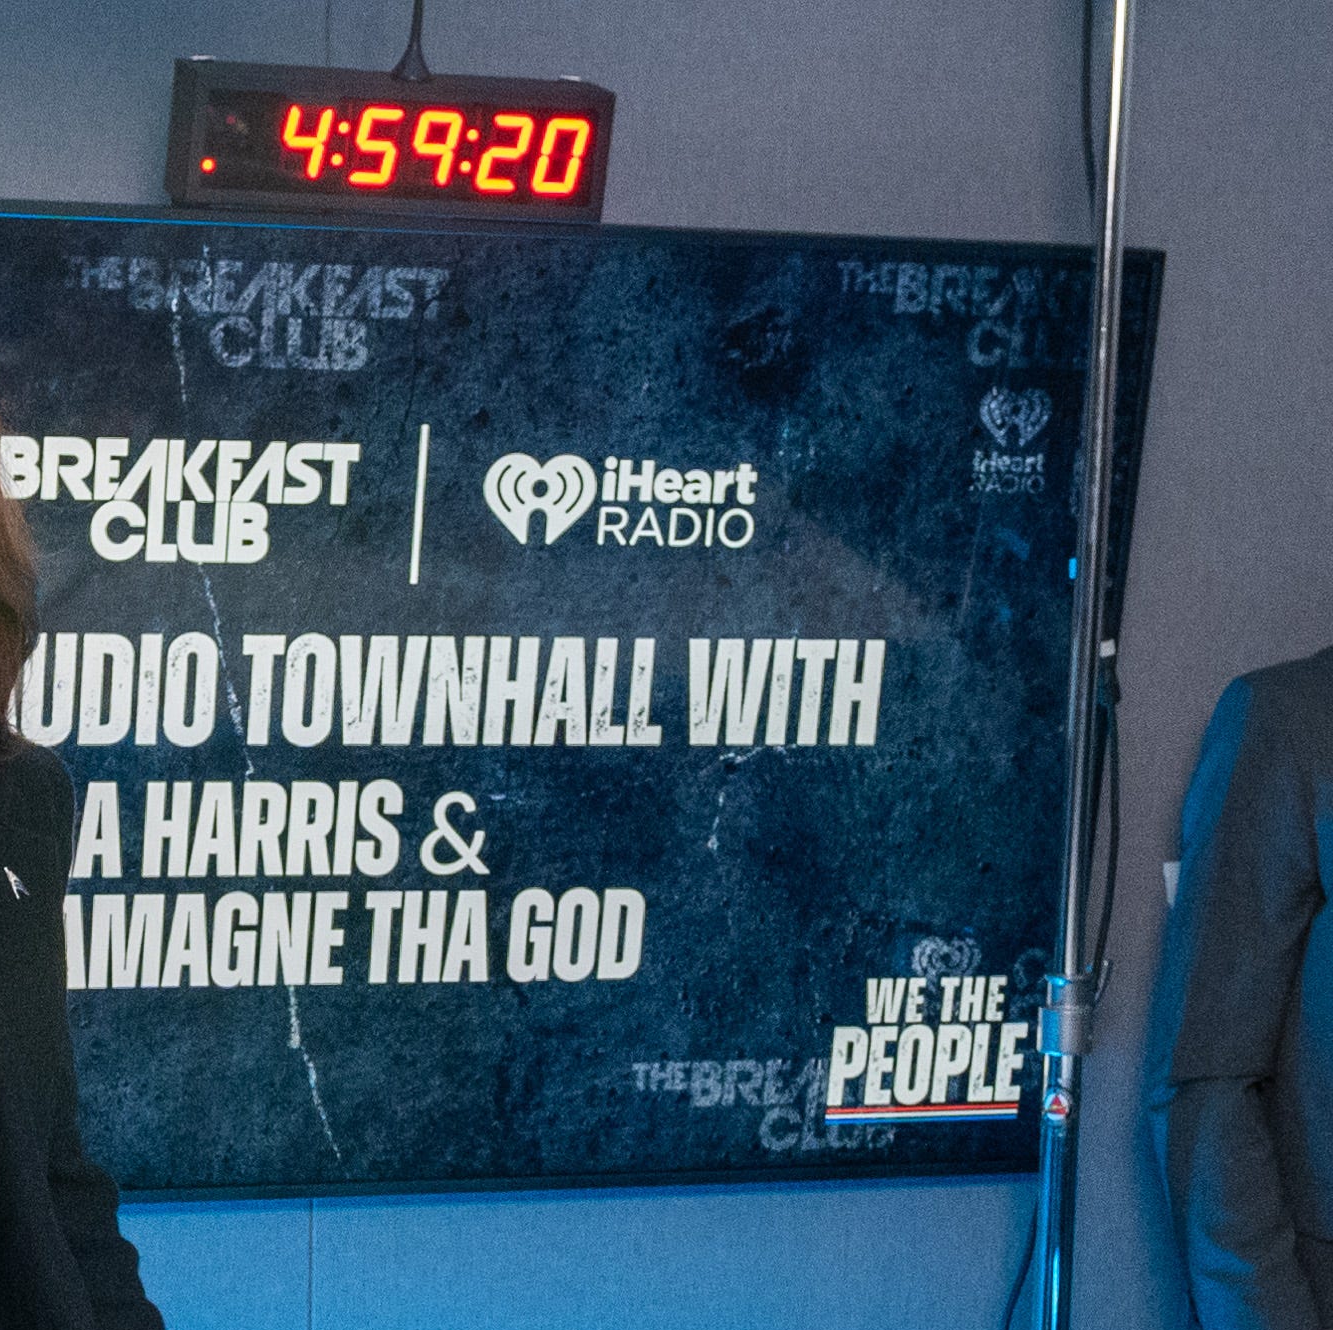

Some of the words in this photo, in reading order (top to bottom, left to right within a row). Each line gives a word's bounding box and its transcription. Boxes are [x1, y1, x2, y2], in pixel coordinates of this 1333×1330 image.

[282, 103, 591, 195] 4:59:20
[209, 314, 370, 371] CLUB
[602, 457, 758, 506] iHeart
[89, 500, 271, 564] CLUB
[596, 507, 757, 548] RADIO
[8, 631, 220, 748] UDIO
[242, 632, 662, 747] TOWNHALL
[689, 637, 886, 746] WITH
[140, 778, 404, 878] HARRIS
[419, 790, 490, 874] &
[364, 889, 489, 984] THA
[506, 886, 646, 983] GOD
[866, 977, 924, 1023] WE
[939, 975, 1007, 1022] THE
[826, 1022, 1029, 1107] PEOPLE
